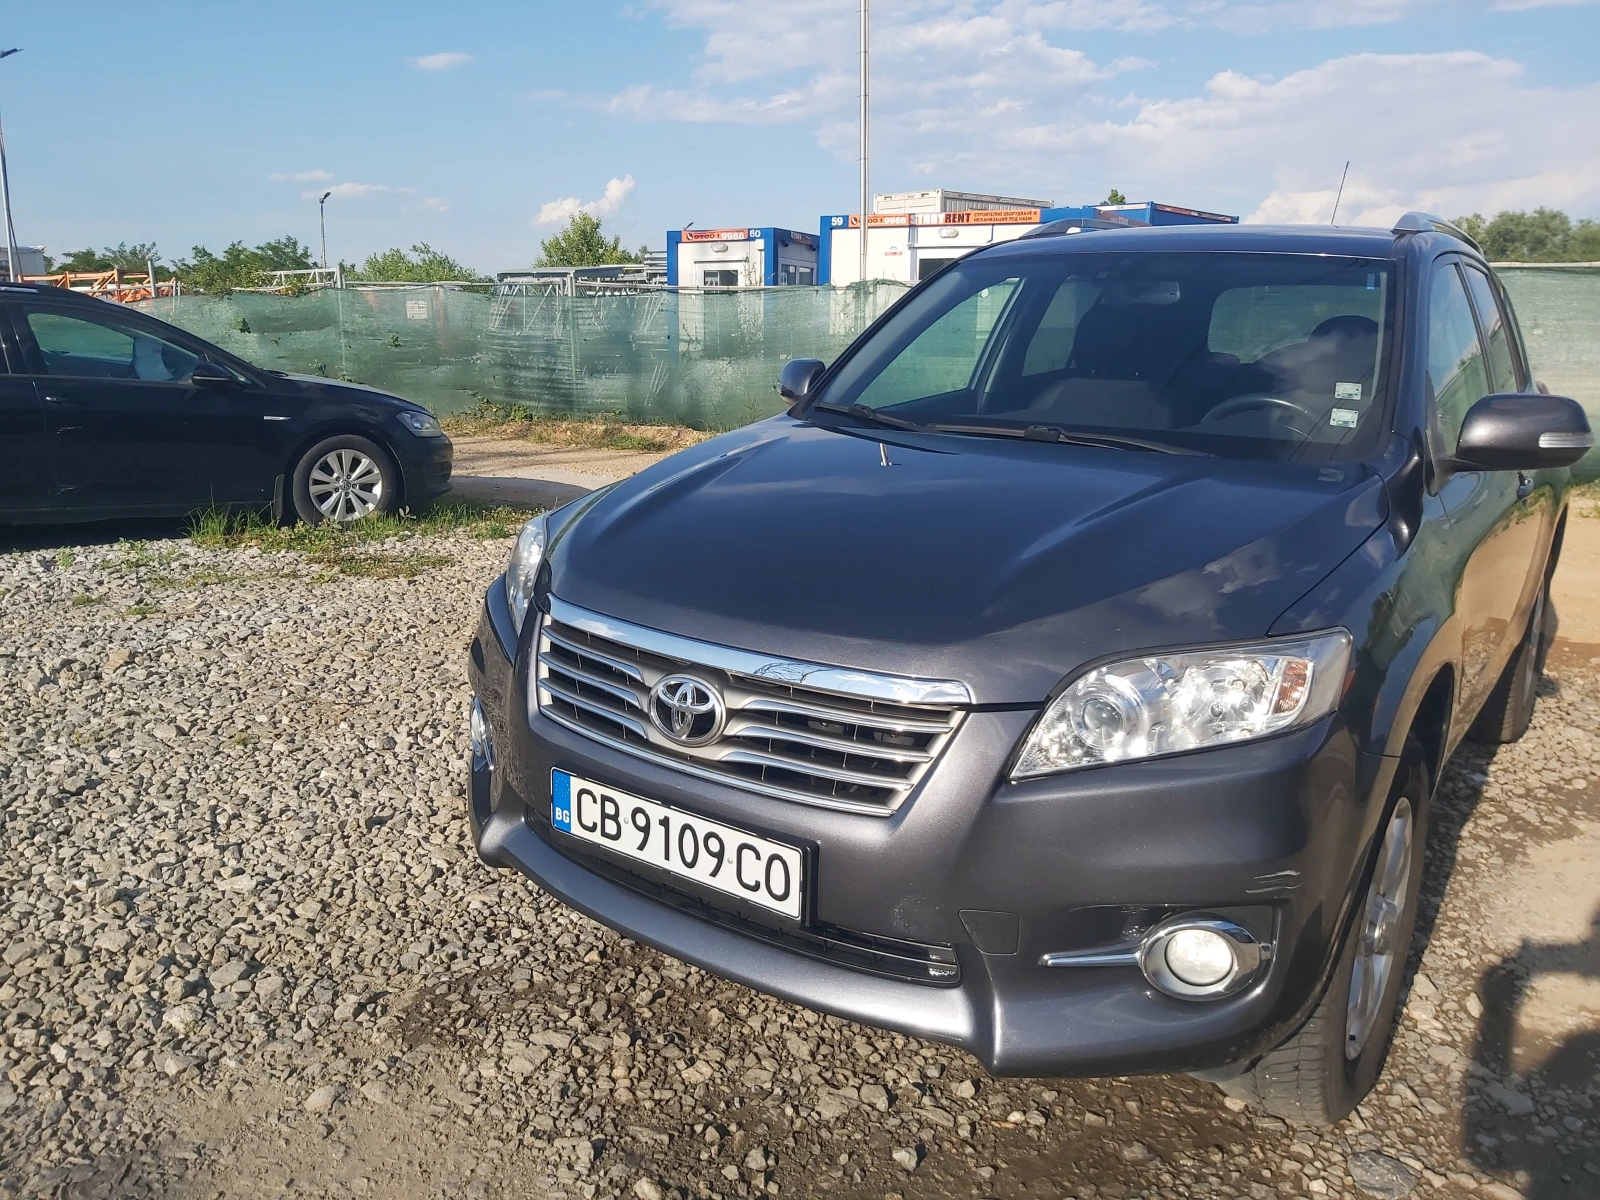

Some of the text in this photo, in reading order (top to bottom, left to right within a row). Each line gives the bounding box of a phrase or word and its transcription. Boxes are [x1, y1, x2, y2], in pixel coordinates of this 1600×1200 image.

[831, 216, 843, 226] 59
[749, 229, 761, 238] 60
[555, 806, 570, 824] BG
[576, 787, 790, 902] CB 9109 CO
